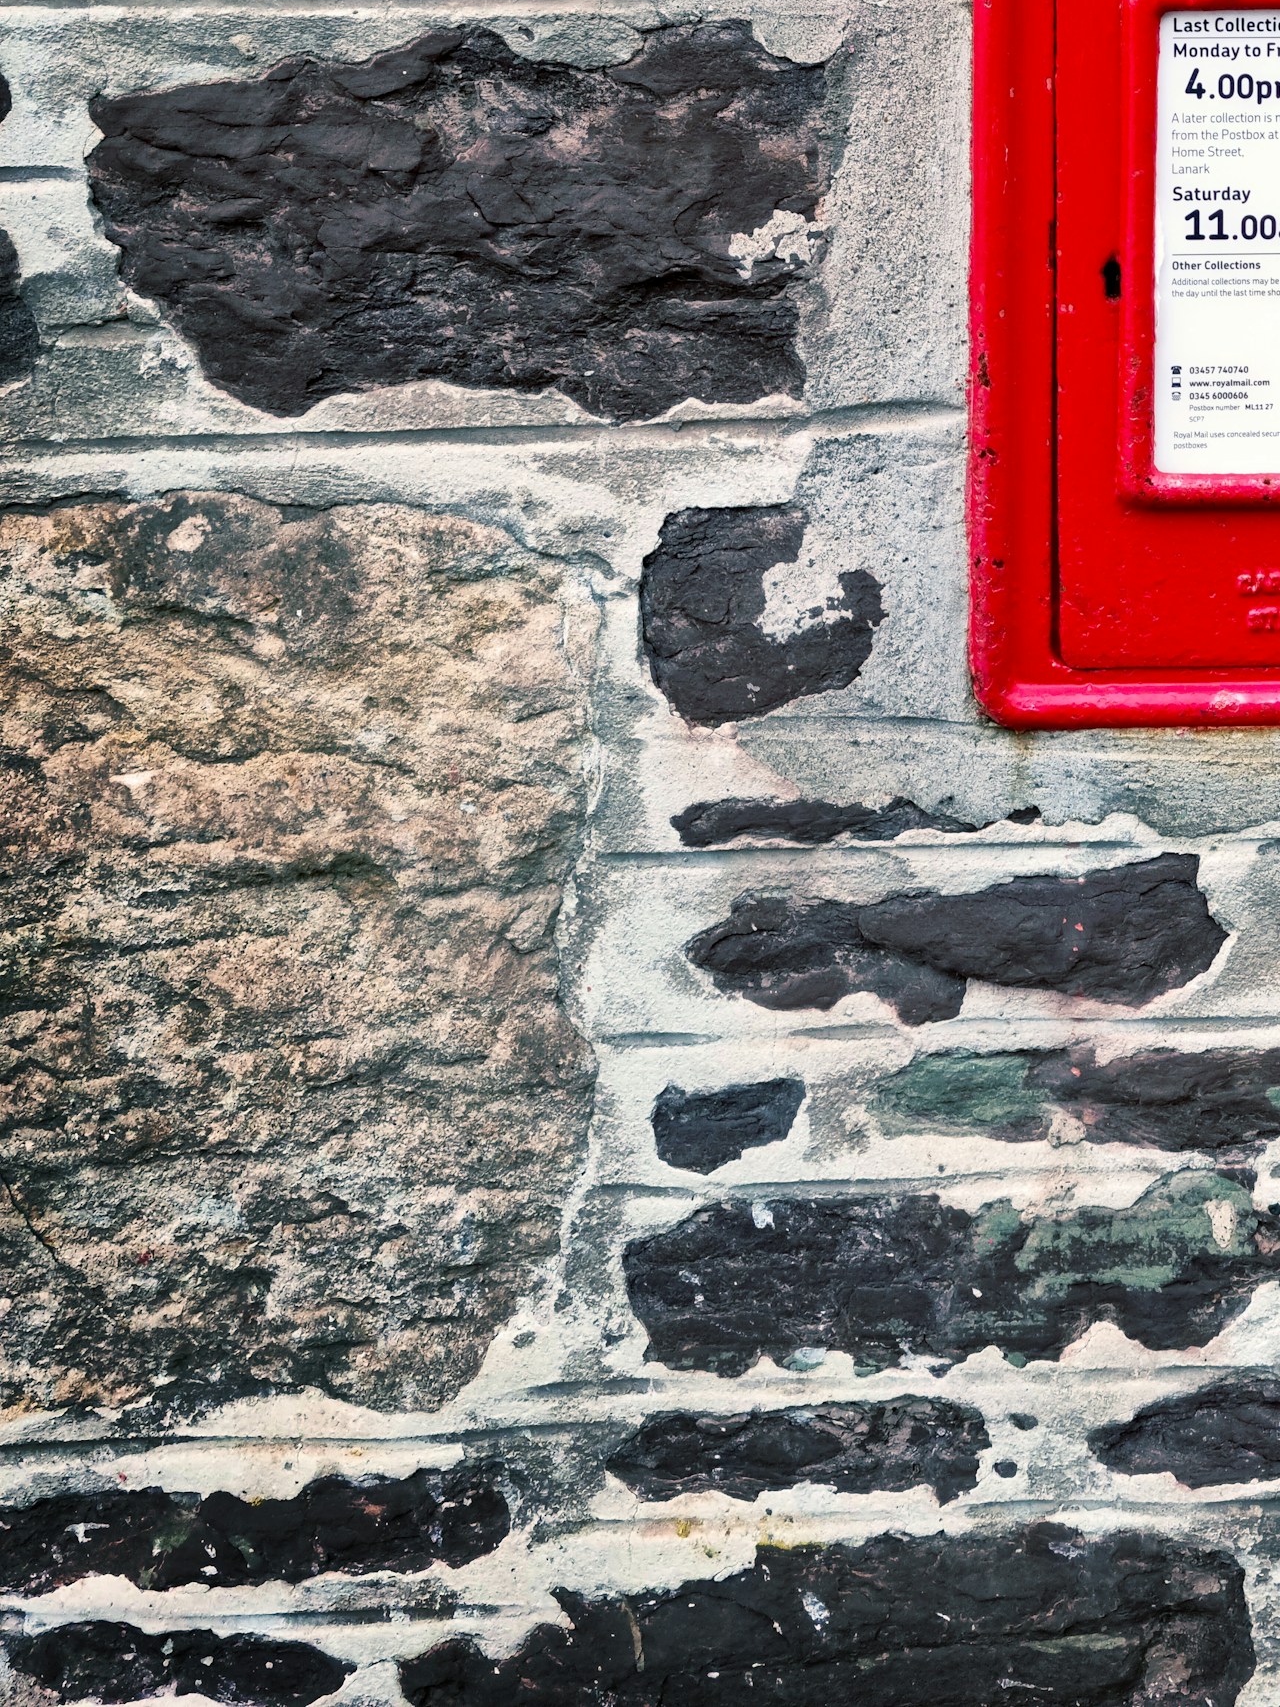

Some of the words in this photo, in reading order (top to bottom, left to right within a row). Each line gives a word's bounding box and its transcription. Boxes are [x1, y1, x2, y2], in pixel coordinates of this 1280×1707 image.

[1172, 17, 1211, 32] Last
[1174, 43, 1240, 61] Monday
[1244, 44, 1261, 57] to
[1172, 113, 1179, 123] A
[1182, 113, 1207, 123] later
[1210, 112, 1261, 123] collection
[1264, 112, 1272, 123] is
[1172, 129, 1198, 140] from
[1201, 129, 1218, 140] the
[1222, 129, 1265, 140] Postbox
[1268, 130, 1279, 139] at
[1172, 147, 1204, 157] Home
[1172, 163, 1210, 174] Lanark
[1173, 186, 1251, 204] Saturday
[1172, 261, 1202, 270] Other
[1205, 260, 1261, 270] Collections
[1186, 289, 1199, 298] day
[1201, 289, 1218, 297] until
[1220, 289, 1232, 297] the
[1189, 366, 1215, 374] 03457
[1218, 366, 1249, 374] 740740
[1189, 379, 1270, 388] www.royalmail.com
[1189, 392, 1210, 400] 0345
[1174, 431, 1192, 440] Royal
[1174, 442, 1207, 450] postboxes
